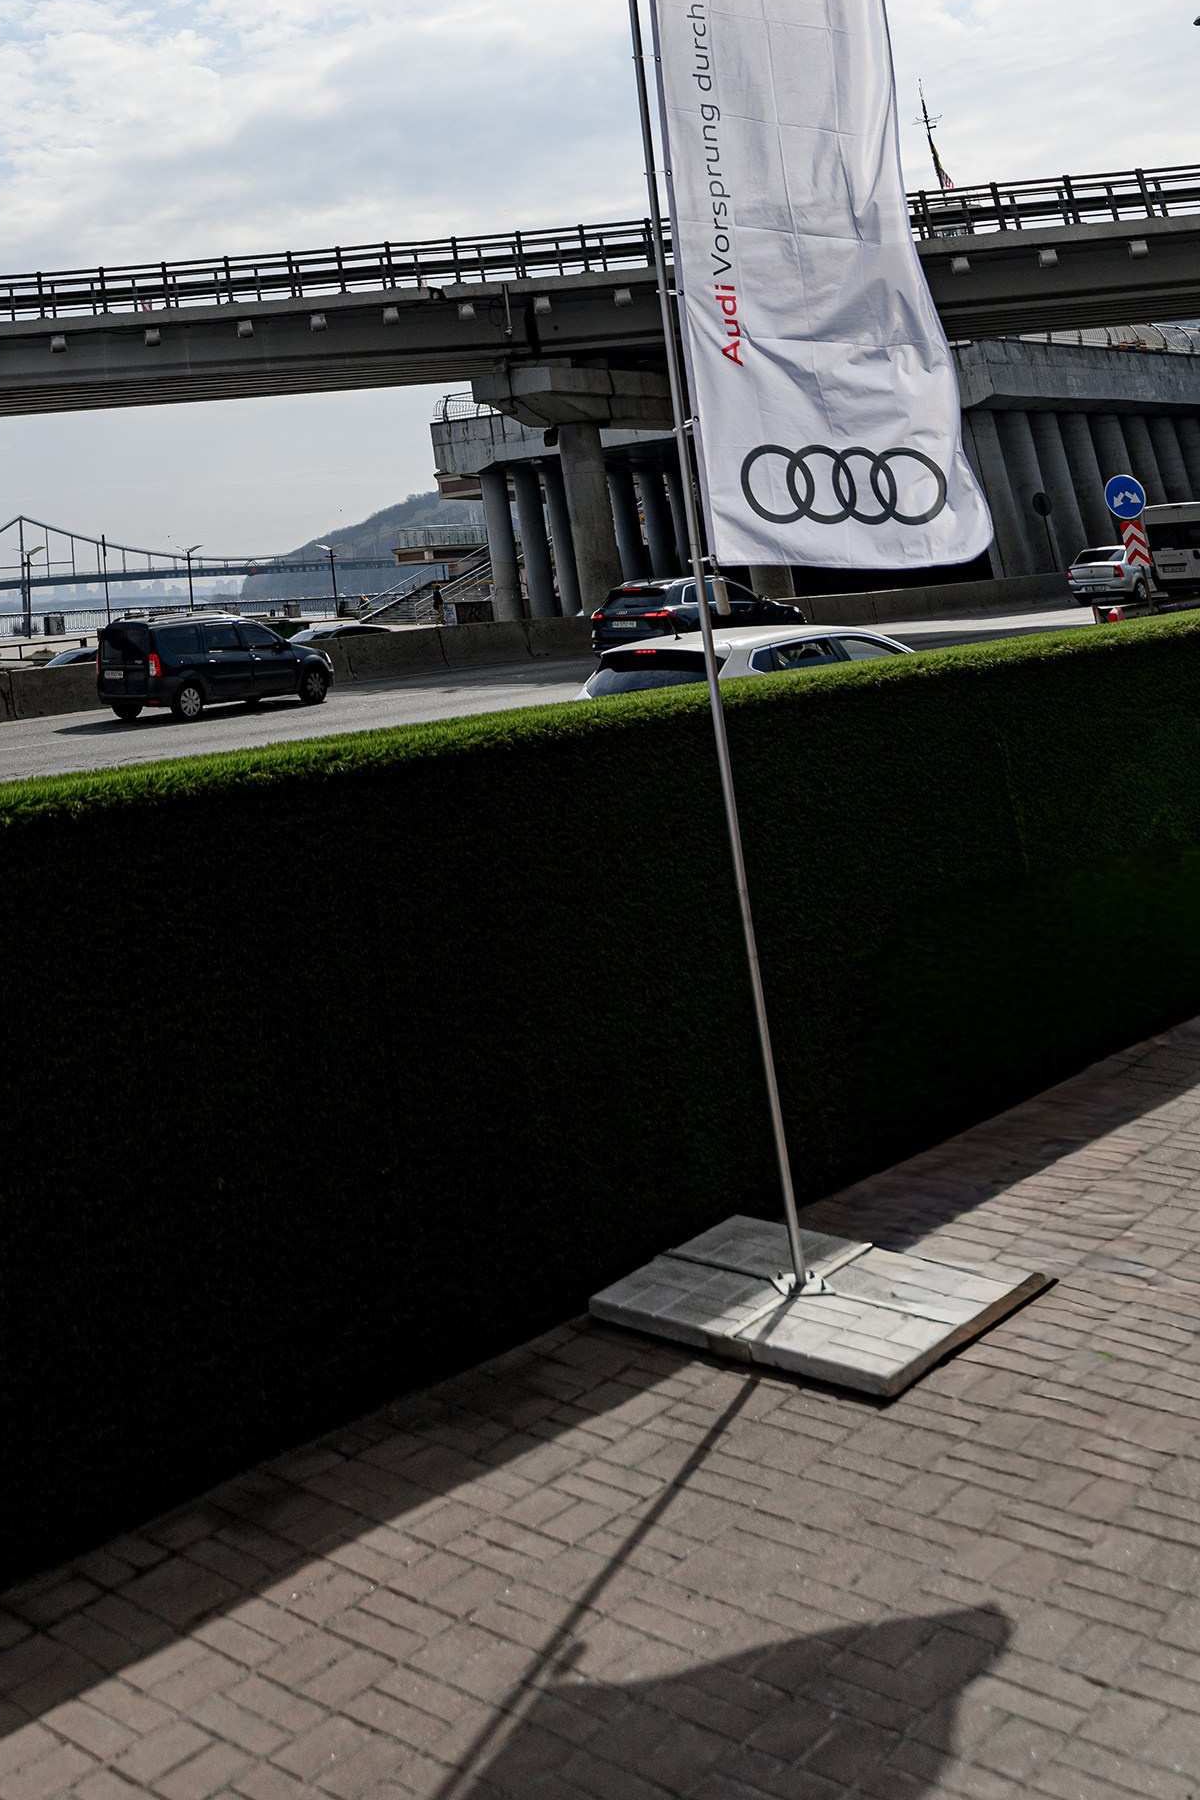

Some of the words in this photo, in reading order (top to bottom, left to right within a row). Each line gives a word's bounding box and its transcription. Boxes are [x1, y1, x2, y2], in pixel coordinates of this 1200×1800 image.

[686, 4, 713, 92] durch
[700, 103, 732, 277] Vorsprung
[713, 284, 746, 368] Audi
